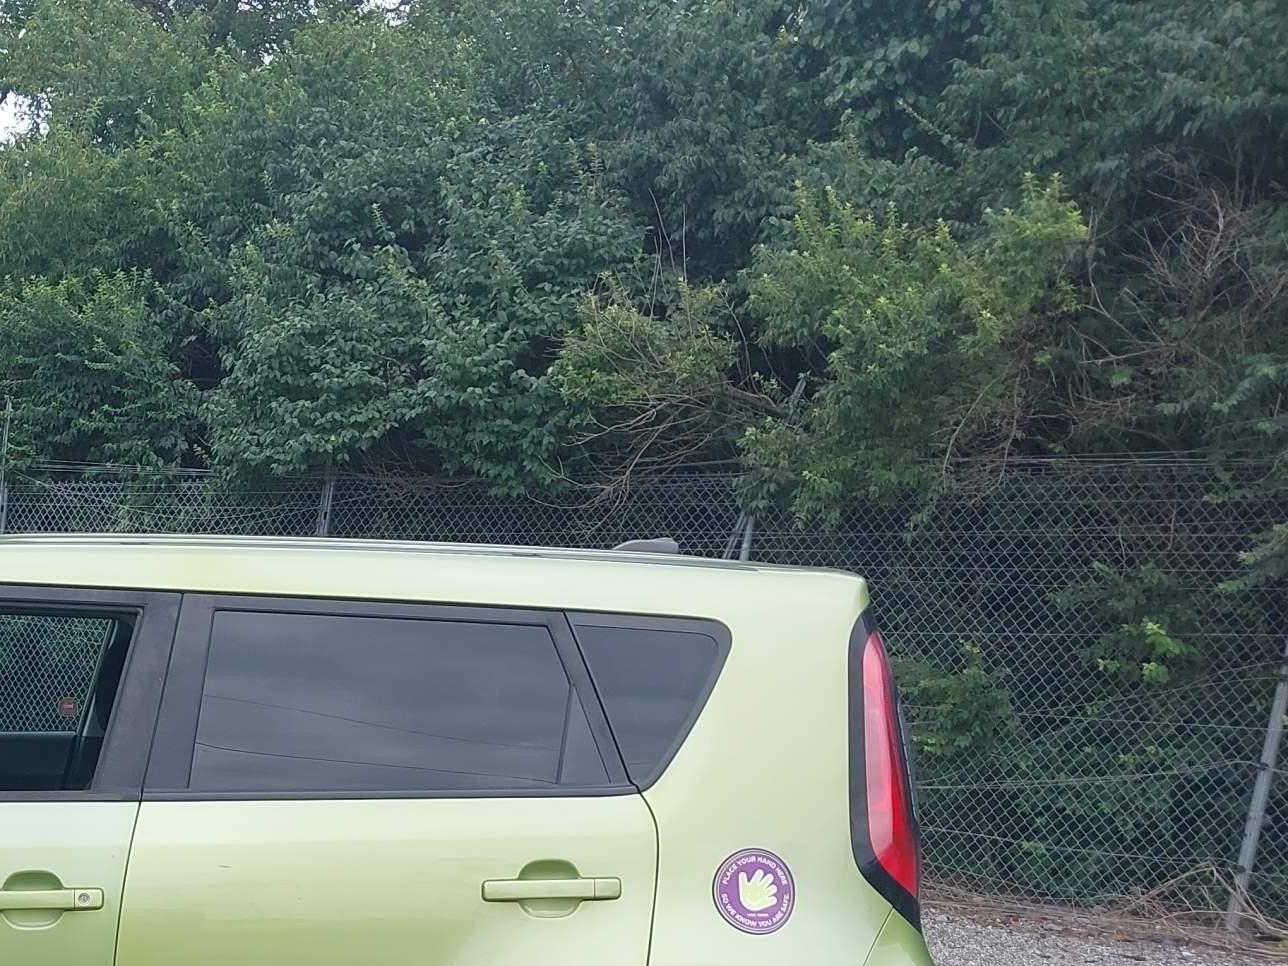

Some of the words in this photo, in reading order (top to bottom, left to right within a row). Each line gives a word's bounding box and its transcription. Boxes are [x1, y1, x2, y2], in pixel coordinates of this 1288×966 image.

[722, 863, 738, 885] PLACE
[737, 855, 756, 866] YOUR
[757, 856, 776, 869] HAND
[775, 868, 788, 886] HERE
[721, 893, 729, 904] SO
[725, 904, 736, 916] WE
[735, 914, 757, 927] KNOW
[758, 919, 772, 928] YOU
[772, 910, 784, 923] ARE
